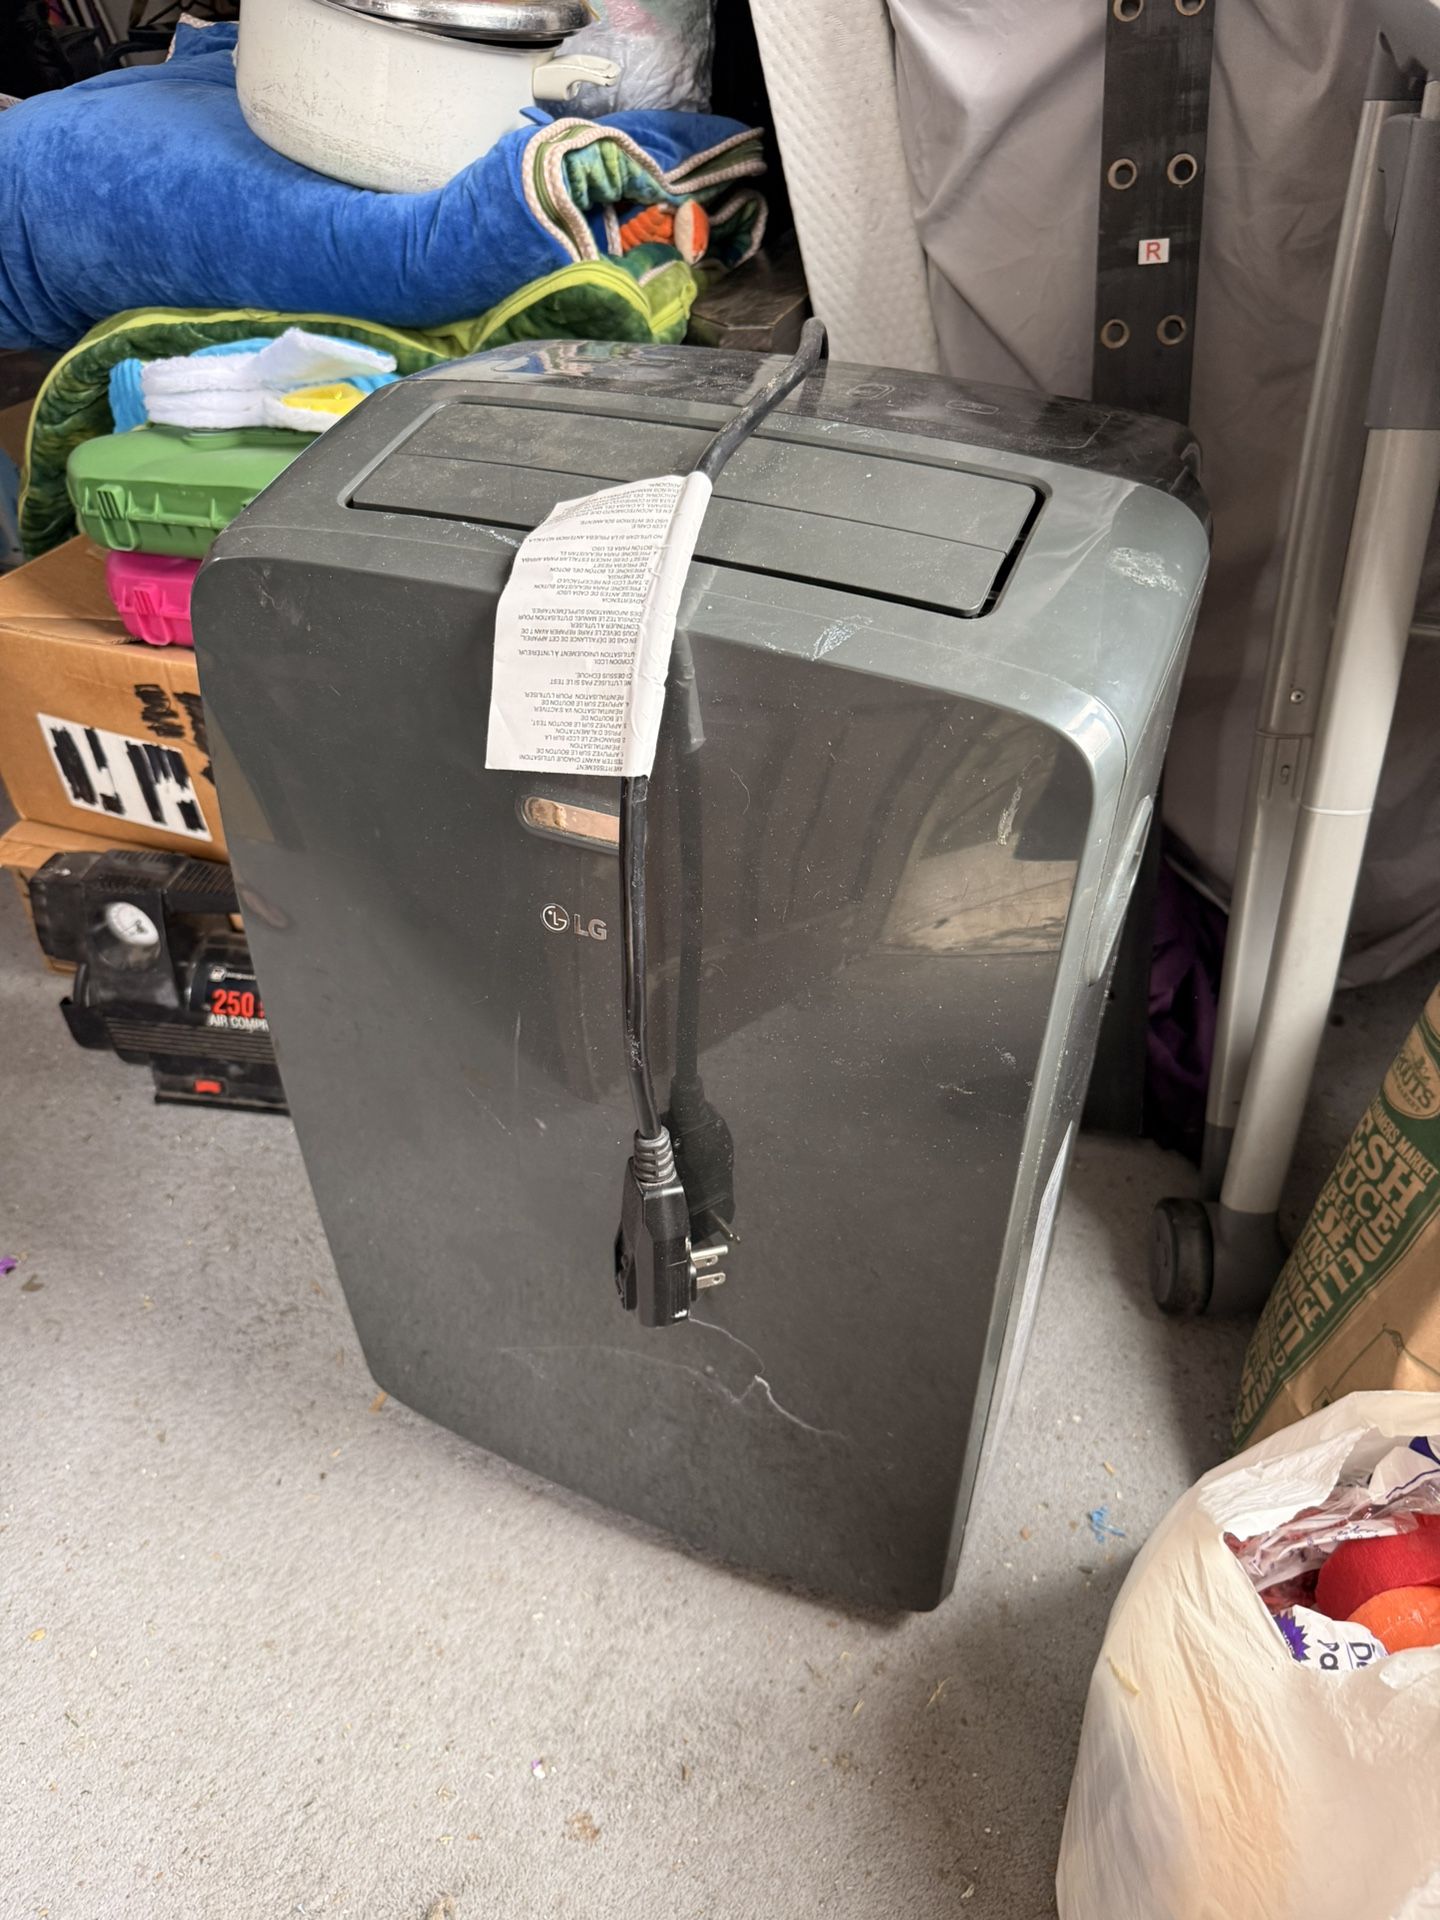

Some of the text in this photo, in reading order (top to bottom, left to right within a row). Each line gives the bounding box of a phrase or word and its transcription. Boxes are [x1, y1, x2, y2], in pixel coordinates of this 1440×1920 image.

[1145, 241, 1161, 261] R
[573, 913, 608, 941] LG
[211, 988, 256, 1018] 250
[207, 1014, 232, 1029] AIR
[1351, 1108, 1427, 1220] ESH
[1394, 1136, 1440, 1184] MARKET
[1310, 1223, 1385, 1313] DELI
